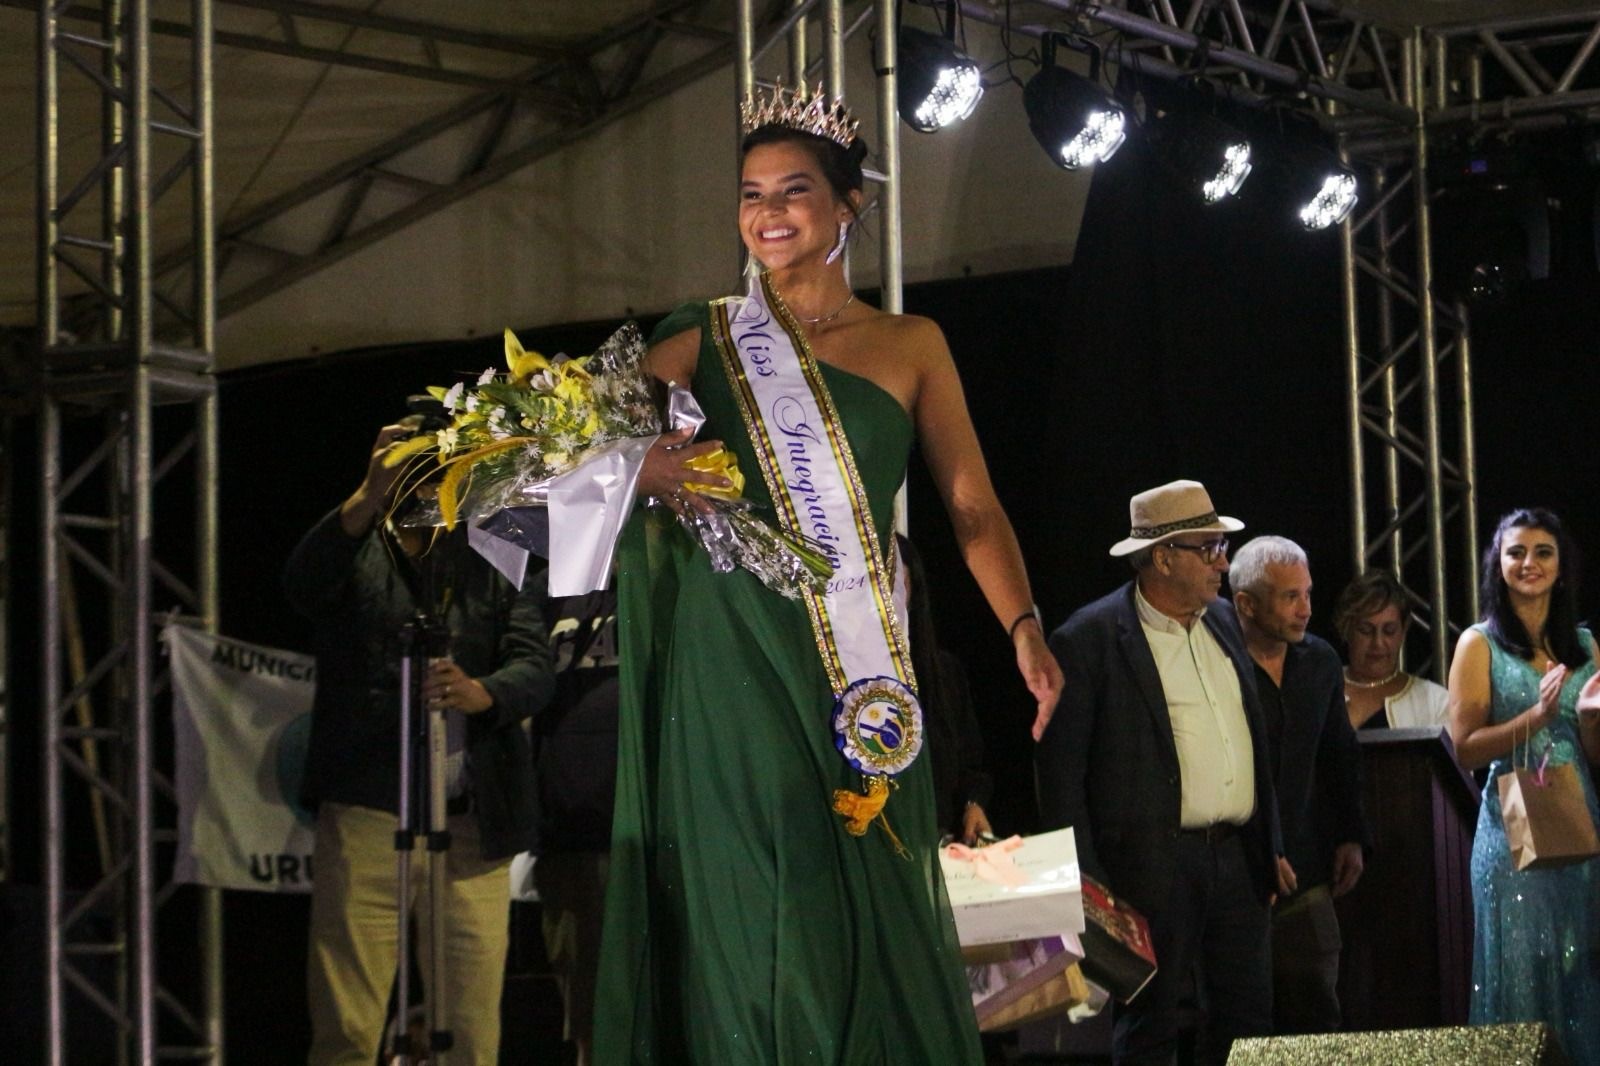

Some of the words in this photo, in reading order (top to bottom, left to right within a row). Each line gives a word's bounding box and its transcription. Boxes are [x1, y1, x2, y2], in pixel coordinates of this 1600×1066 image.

[734, 295, 777, 377] Miss
[772, 396, 847, 569] Integración
[826, 575, 865, 594] 2024
